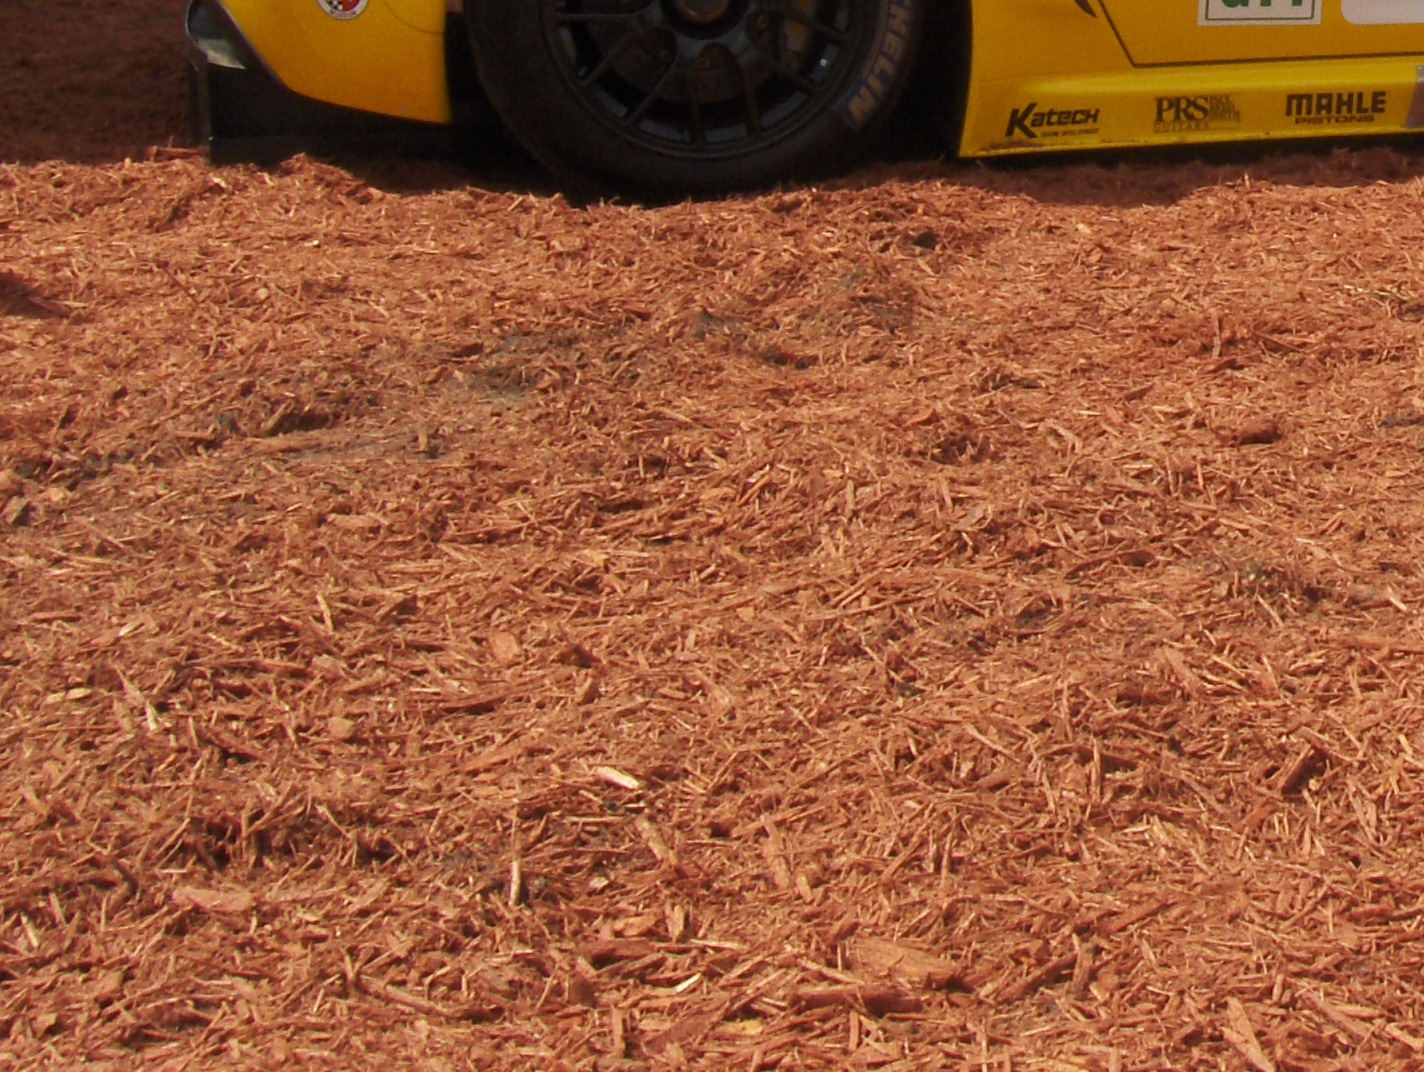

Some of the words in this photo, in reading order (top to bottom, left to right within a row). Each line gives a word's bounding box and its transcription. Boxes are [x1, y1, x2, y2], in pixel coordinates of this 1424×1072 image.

[1155, 95, 1209, 122] PRS
[1285, 90, 1387, 117] MAHLE
[1004, 102, 1100, 139] Katech
